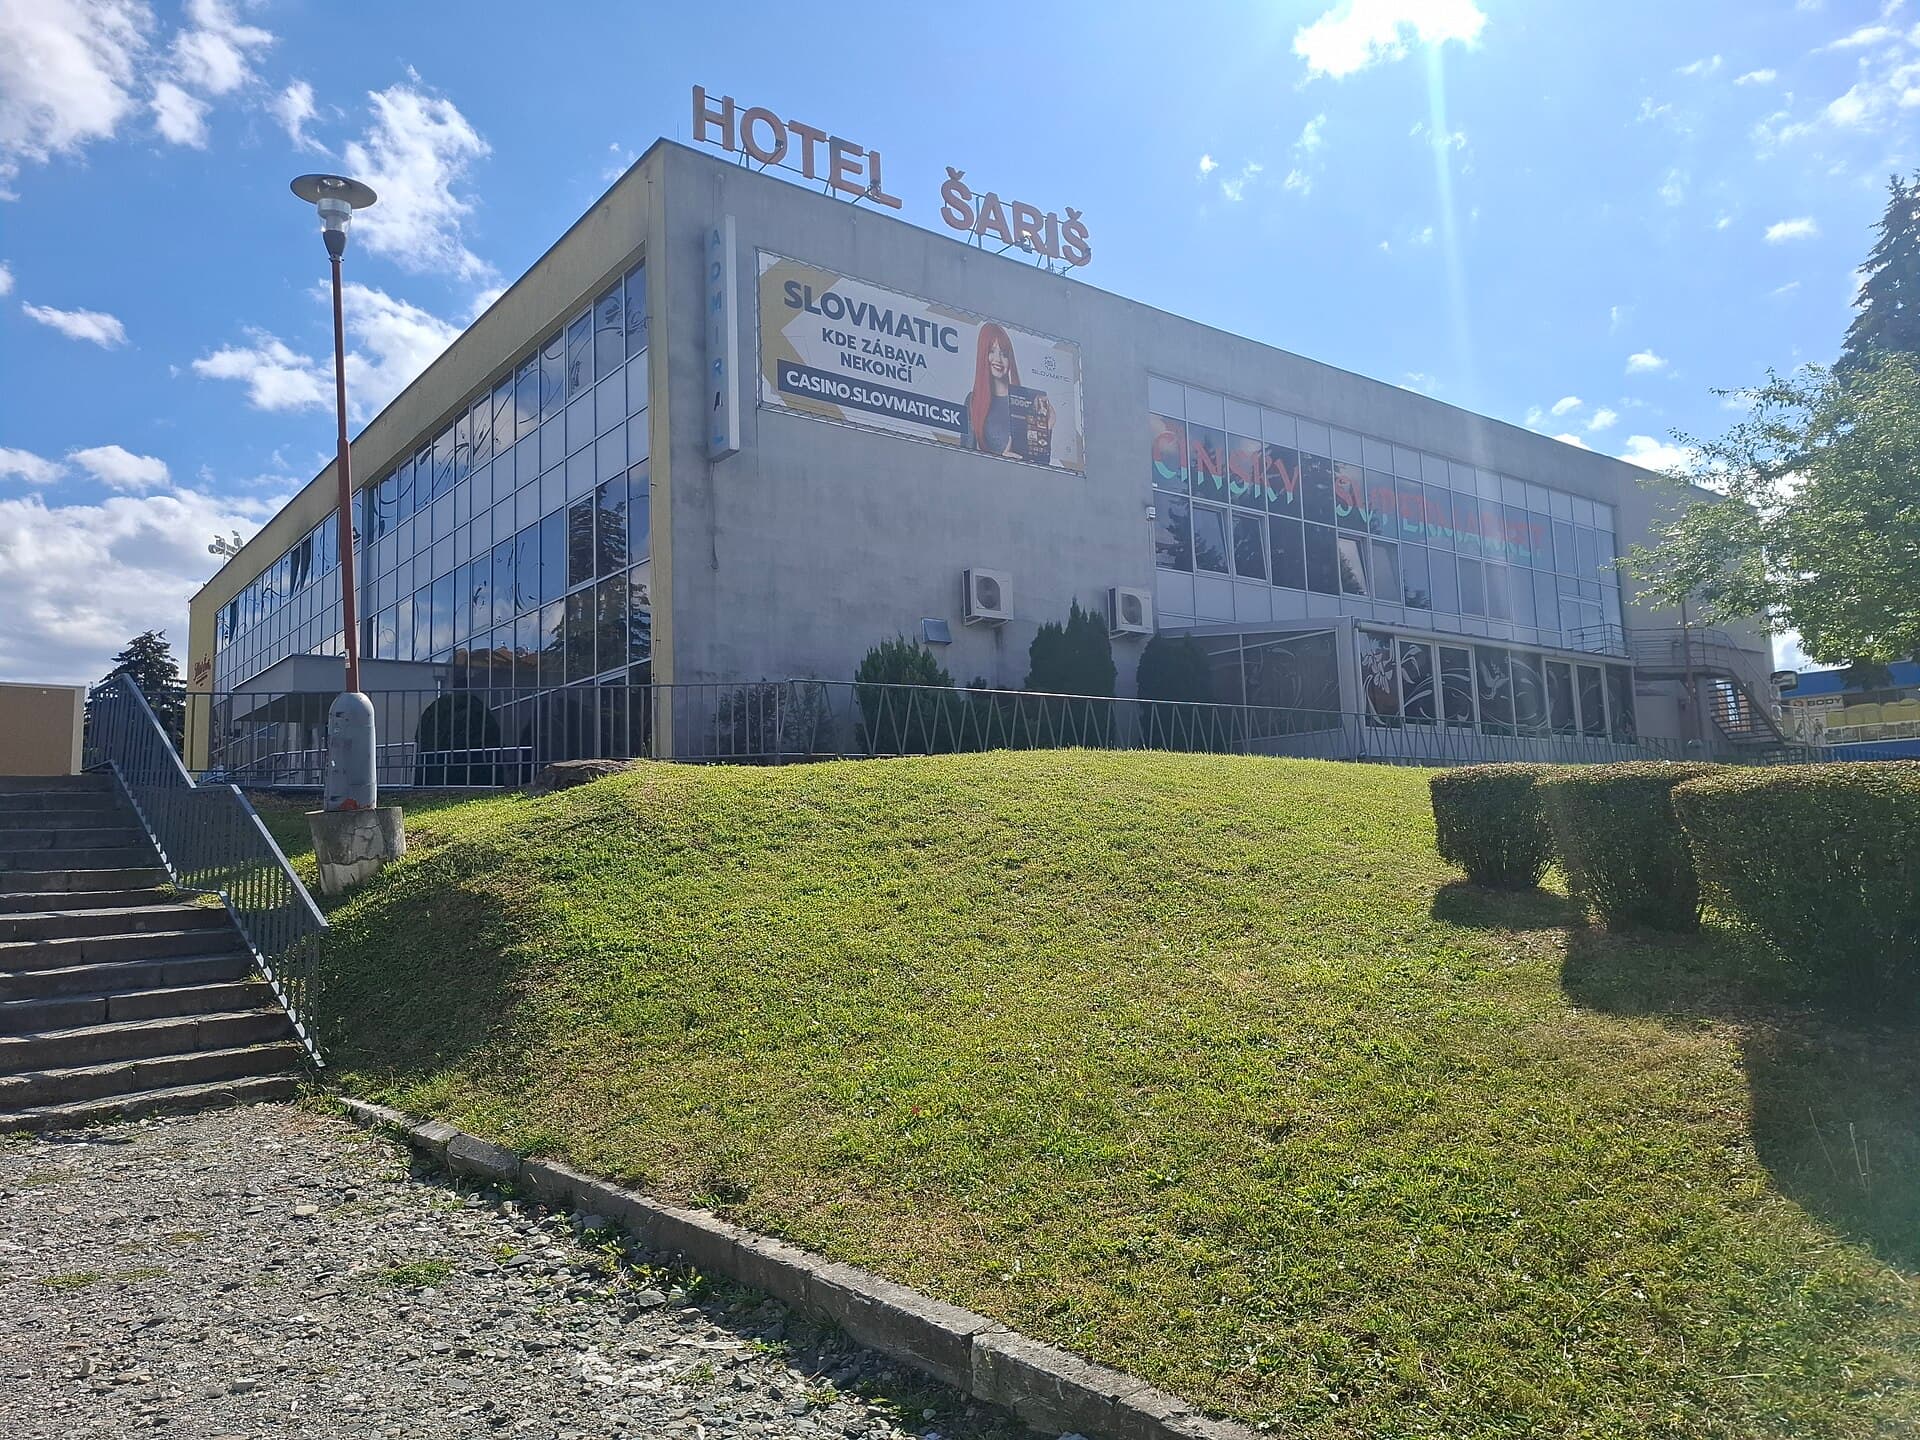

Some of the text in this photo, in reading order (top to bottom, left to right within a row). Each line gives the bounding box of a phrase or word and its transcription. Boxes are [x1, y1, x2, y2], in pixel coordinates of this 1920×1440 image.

[692, 84, 1092, 266] HOTEL ŠARIŠ
[783, 280, 959, 353] SLOVMATIC
[821, 327, 927, 369] KDE ZÁBAVA
[839, 353, 912, 384] NEKONČÍ
[786, 370, 961, 426] CASINO.SLOVMATIC.SK
[1031, 368, 1072, 383] SLOVMATIC
